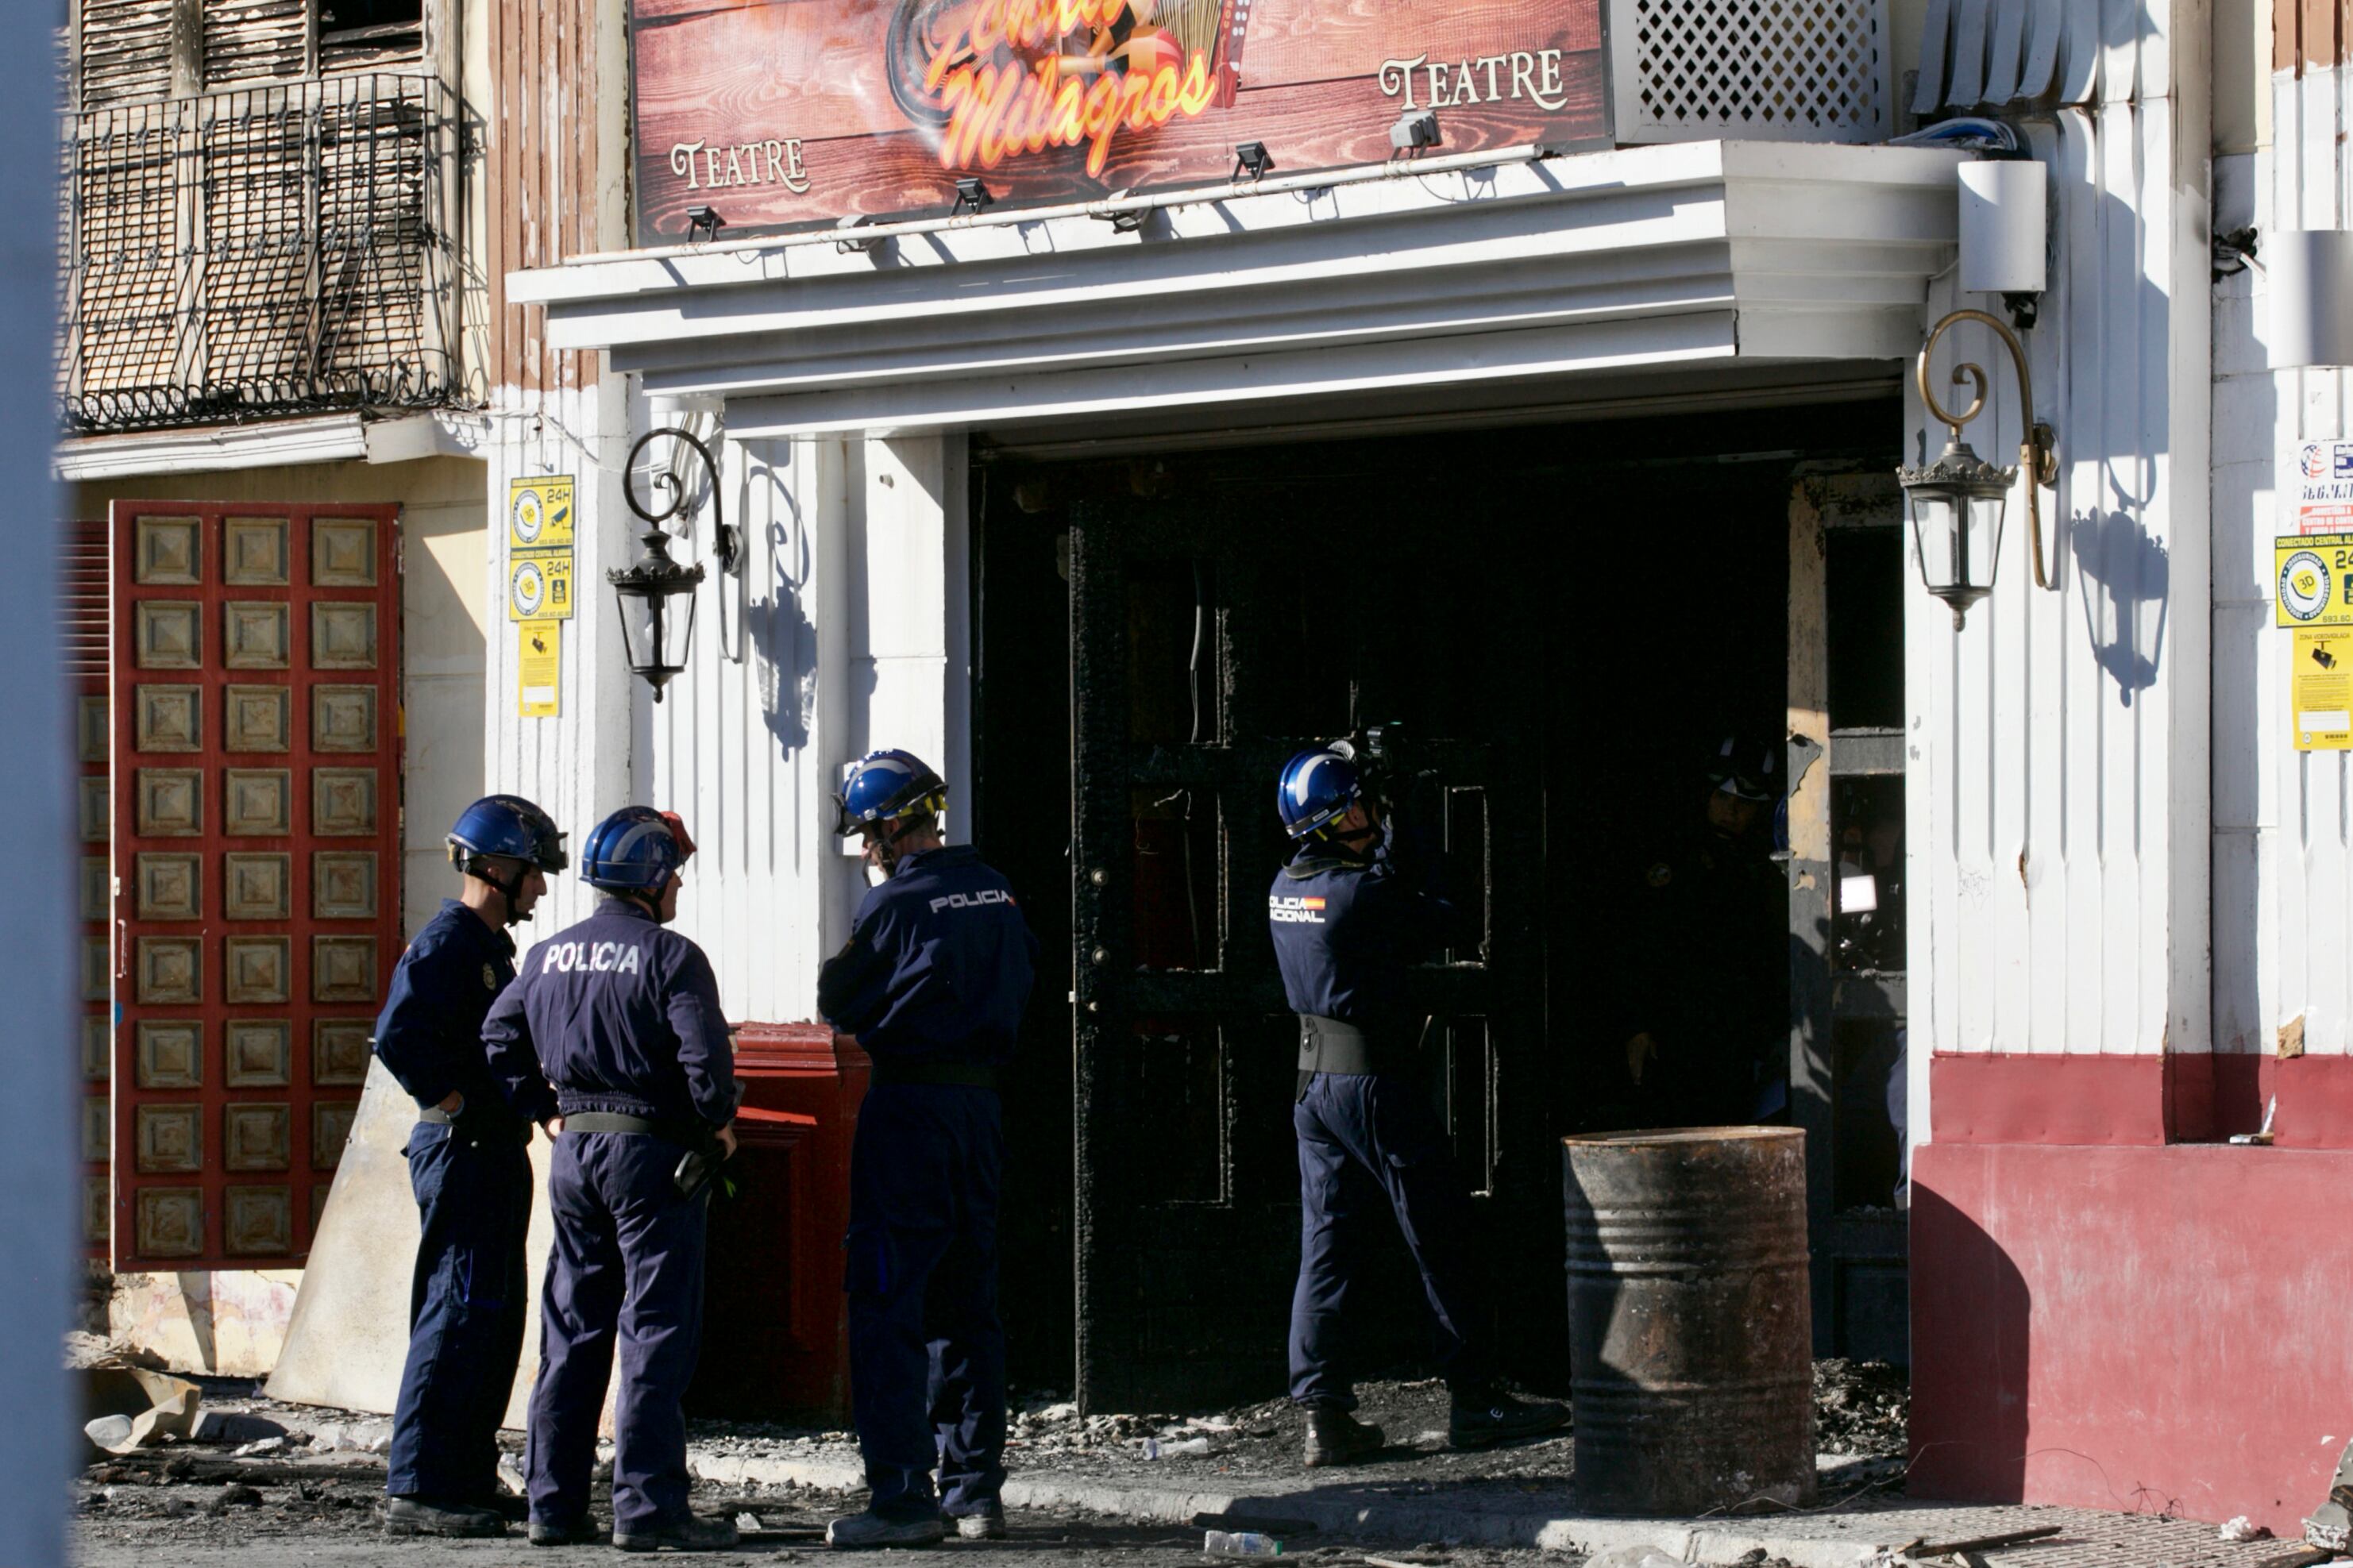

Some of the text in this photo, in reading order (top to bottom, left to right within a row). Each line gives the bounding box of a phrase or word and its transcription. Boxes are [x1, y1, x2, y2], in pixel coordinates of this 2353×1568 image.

[1378, 49, 1568, 110] TEATRE
[939, 48, 1219, 178] Milagros
[671, 137, 811, 194] TEATRE
[547, 487, 571, 503] 24H
[2276, 537, 2314, 547] CONECTADO
[2315, 535, 2343, 546] CENTRAL
[547, 561, 570, 576] 24H
[2299, 575, 2315, 590] 3D
[928, 889, 1012, 914] POLICIA
[542, 941, 639, 975] POLICIA
